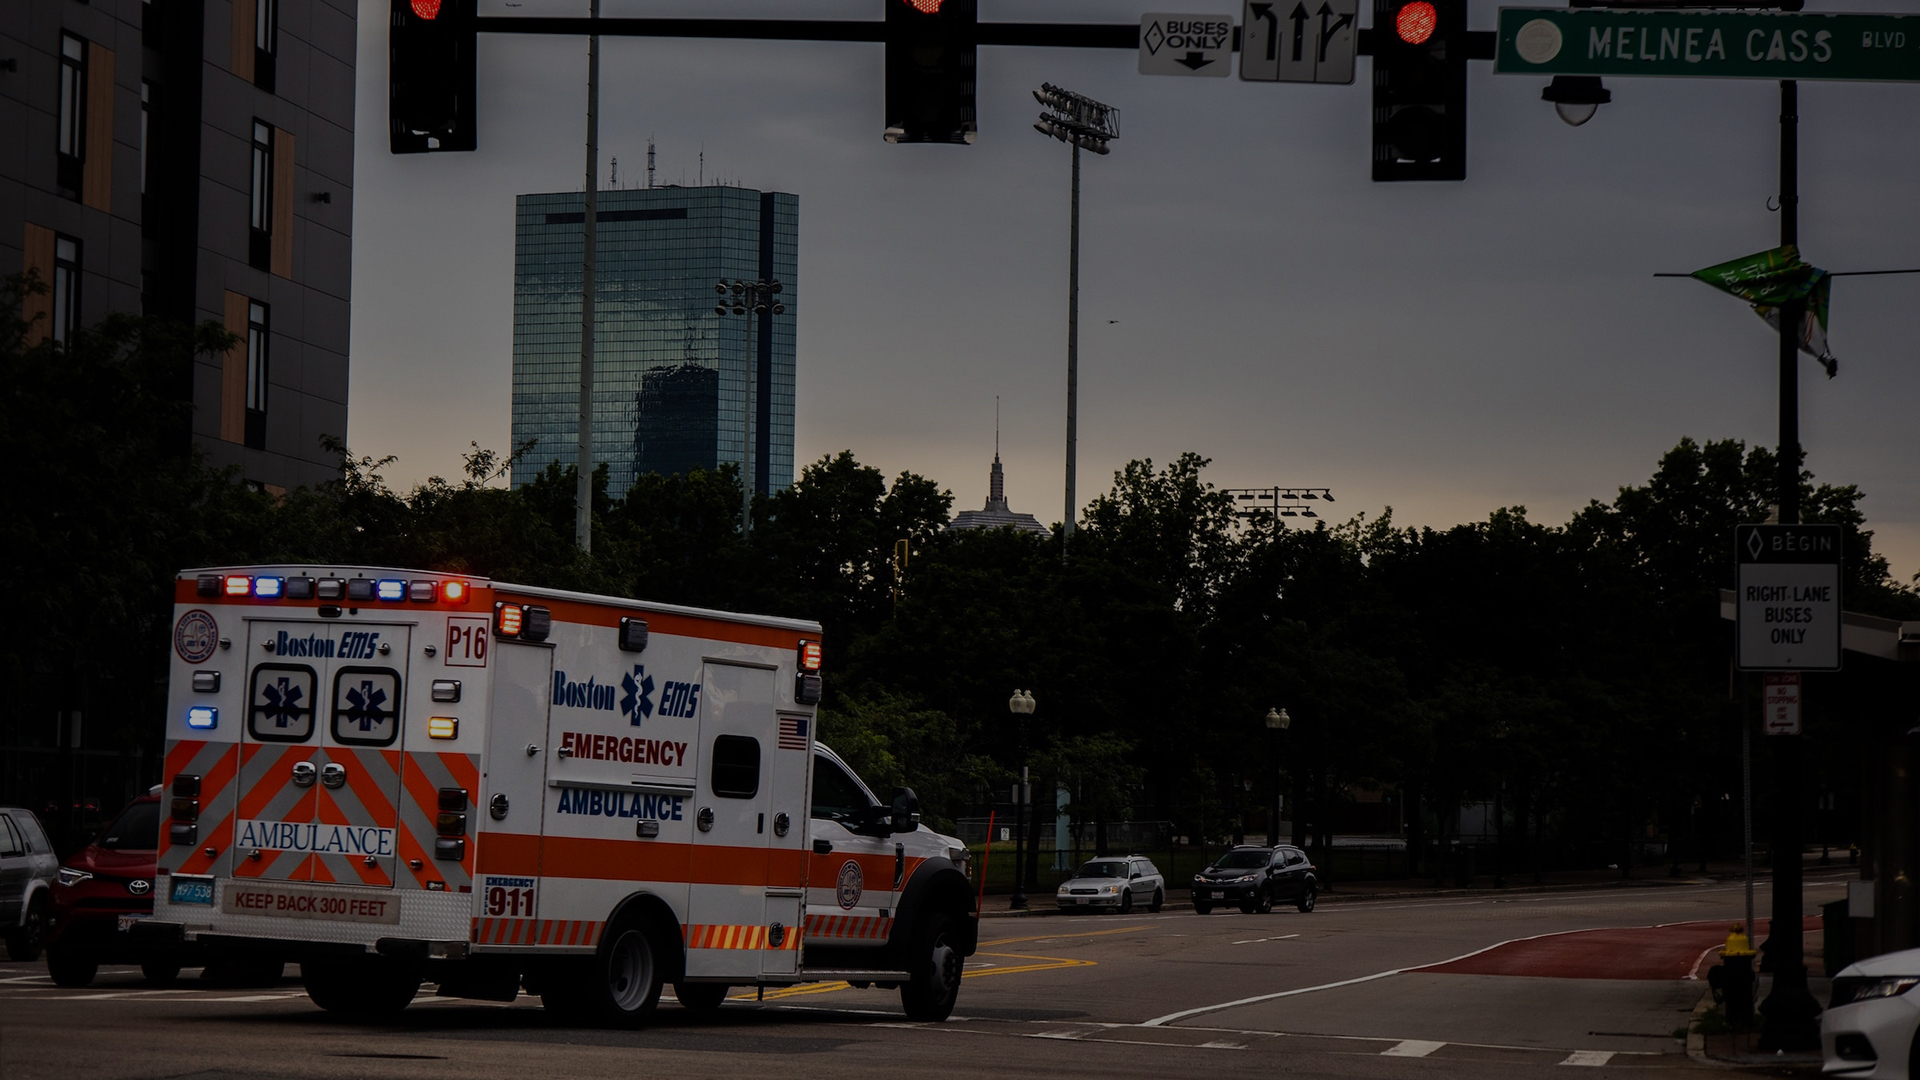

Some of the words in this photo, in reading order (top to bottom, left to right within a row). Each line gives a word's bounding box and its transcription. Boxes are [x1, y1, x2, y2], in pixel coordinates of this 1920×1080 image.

[1167, 21, 1228, 35] BUSES
[1167, 35, 1227, 49] ONLY
[1588, 26, 1726, 63] MELNEA
[1745, 28, 1833, 64] CASS
[1862, 31, 1905, 49] BLVD
[1772, 535, 1832, 551] BEGIN
[1747, 586, 1787, 601] RIGHT
[1794, 586, 1831, 602] LANE
[1765, 607, 1812, 623] BUSES
[276, 630, 334, 658] Boston
[337, 631, 380, 660] EMS
[449, 625, 486, 660] P16
[1771, 628, 1806, 644] ONLY
[553, 669, 615, 711] Boston
[658, 680, 700, 718] EMS
[562, 731, 688, 767] EMERGENCY
[557, 787, 683, 821] AMBULANCE
[239, 821, 392, 856] AMBULANCE
[486, 876, 534, 888] EMERGENCY
[235, 891, 273, 910] KEEP
[277, 894, 317, 913] BACK
[320, 896, 346, 915] 300
[350, 898, 387, 917] FEET
